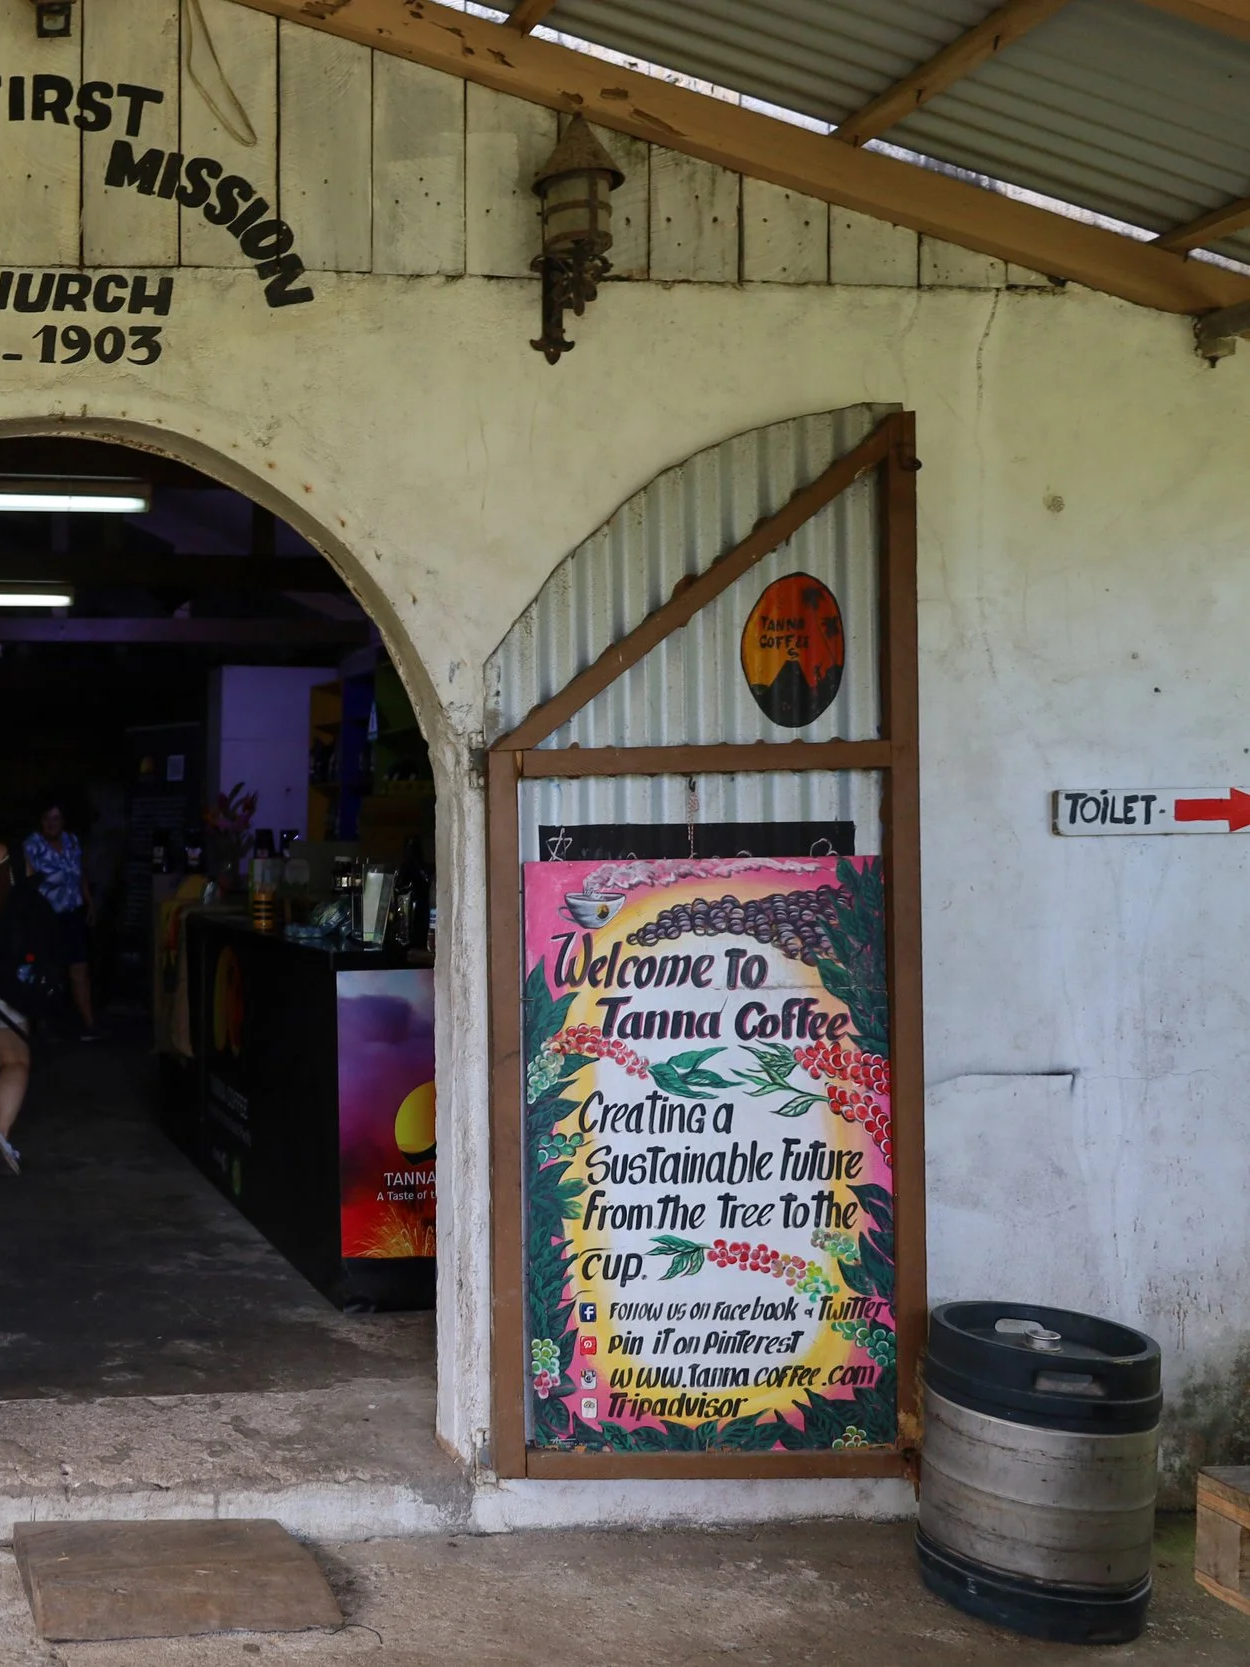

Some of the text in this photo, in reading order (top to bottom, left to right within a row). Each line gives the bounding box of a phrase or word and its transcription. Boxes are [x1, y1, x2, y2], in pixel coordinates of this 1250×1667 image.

[104, 139, 315, 308] MISSION
[33, 325, 163, 365] 1903
[760, 615, 806, 632] TANNA
[550, 931, 715, 989] Welcome
[596, 996, 850, 1041] Tanna Coffee
[578, 1090, 735, 1135] Creating a
[383, 1171, 436, 1187] TANNA
[585, 1137, 864, 1186] Sustainable Future
[376, 1192, 384, 1201] A
[387, 1190, 414, 1201] Taste
[417, 1190, 428, 1199] of
[582, 1190, 652, 1231] From
[673, 1335, 701, 1355] on
[607, 1391, 749, 1421] Tripadvisor
